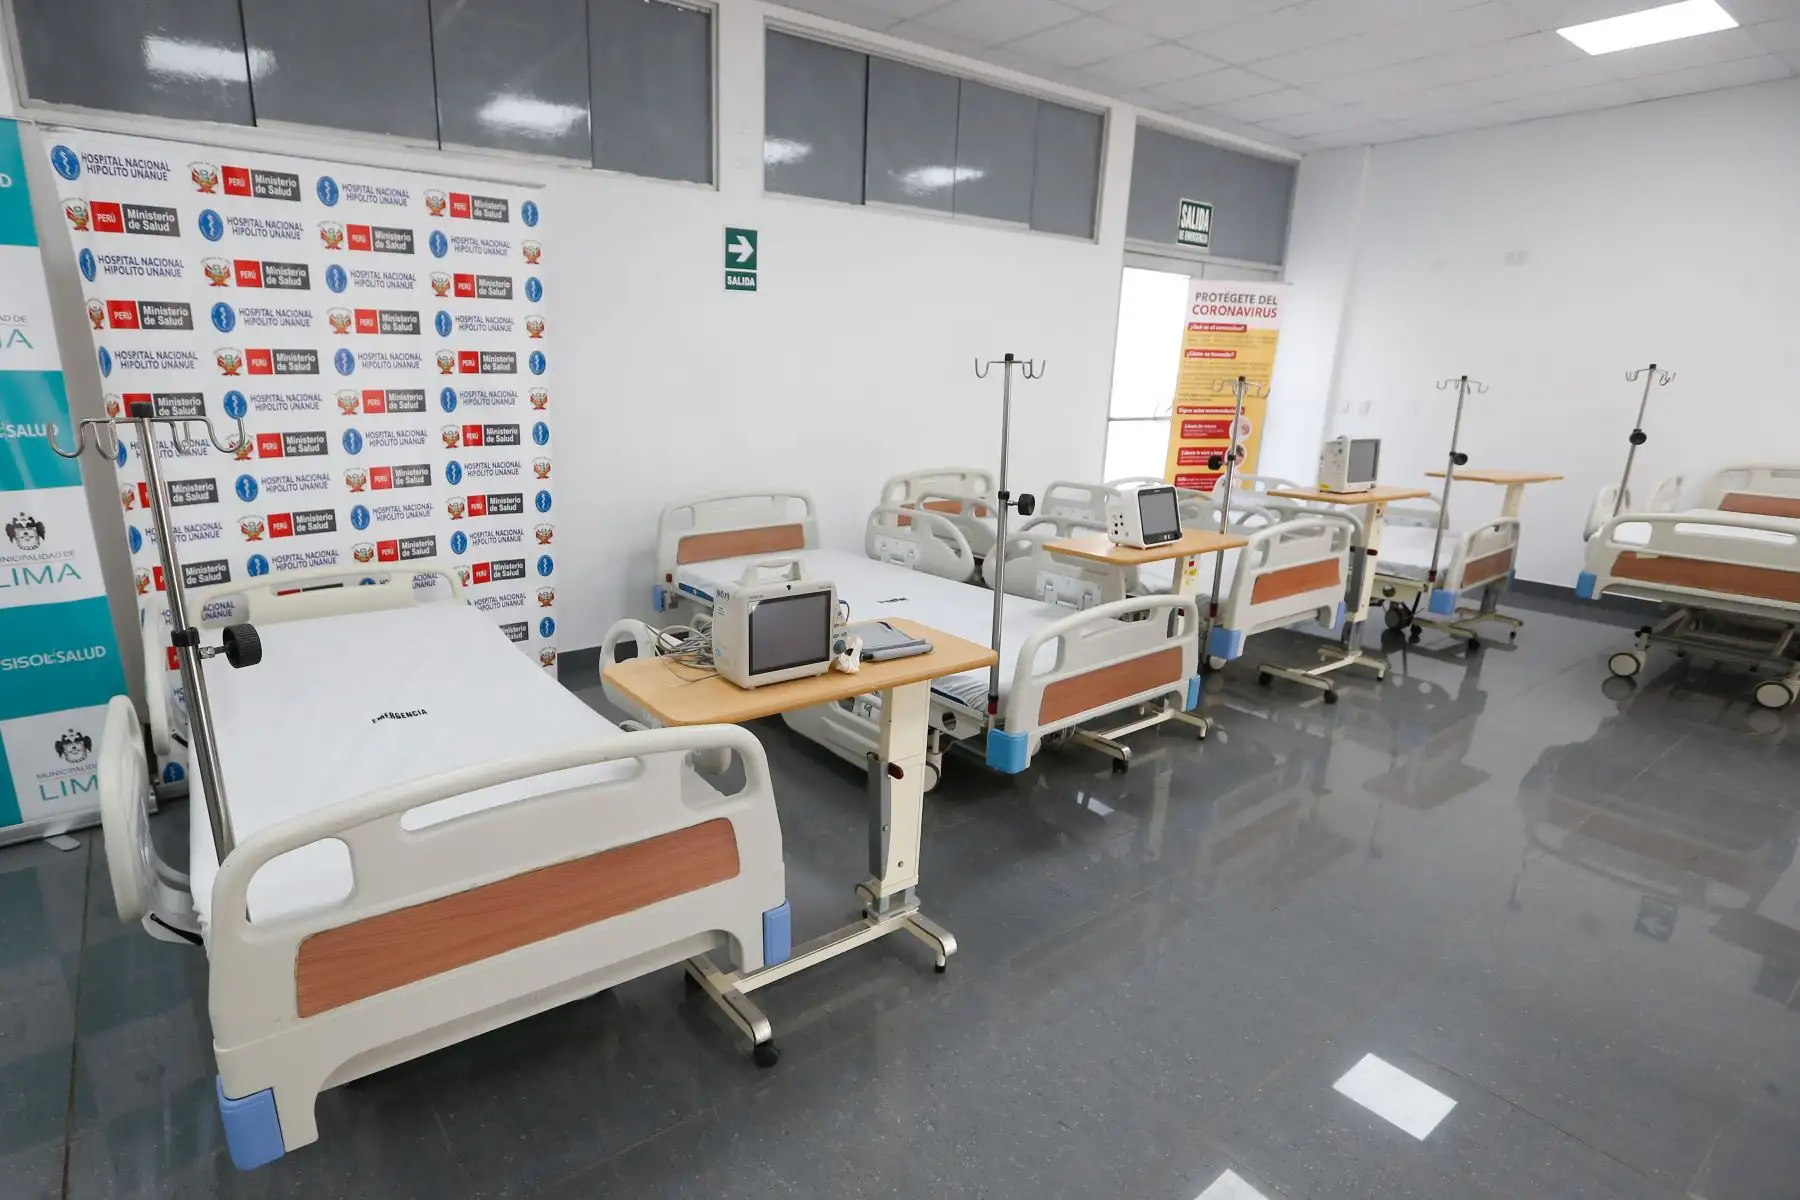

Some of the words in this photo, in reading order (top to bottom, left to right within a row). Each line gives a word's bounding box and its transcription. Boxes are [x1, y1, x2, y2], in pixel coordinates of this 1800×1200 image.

[81, 153, 124, 167] HOSPITAL
[125, 158, 171, 172] NACIONAL
[130, 168, 167, 181] UNANUE
[255, 174, 297, 188] Ministerio
[255, 184, 266, 194] de
[268, 185, 292, 196] Salud
[474, 199, 507, 211] Ministerio
[127, 208, 175, 222] Ministerio
[474, 208, 482, 217] de
[483, 209, 502, 219] Salud
[1180, 203, 1210, 232] SALIDA
[128, 219, 140, 230] de
[142, 220, 170, 232] Salud
[227, 217, 267, 228] HOSPITAL
[266, 220, 304, 231] NACIONAL
[270, 230, 301, 240] UNANUE
[374, 230, 411, 242] Ministerio
[375, 239, 384, 248] de
[386, 240, 406, 250] Salud
[97, 255, 140, 268] HOSPITAL
[141, 257, 184, 268] NACIONAL
[146, 267, 181, 278] UNANUE
[266, 265, 306, 277] Ministerio
[266, 275, 277, 285] de
[278, 275, 302, 286] Salud
[479, 278, 510, 288] Ministerio
[727, 275, 755, 286] SALIDA
[478, 287, 487, 295] de
[488, 287, 506, 296] Salud
[1195, 291, 1256, 304] PROTÉGETE
[1258, 295, 1278, 305] DEL
[143, 305, 188, 316] Ministerio
[239, 308, 274, 317] HOSPITAL
[275, 309, 313, 318] NACIONAL
[1192, 304, 1278, 318] CORONAVIRUS
[144, 315, 155, 325] de
[158, 315, 183, 326] Salud
[280, 318, 310, 327] UNANUE
[381, 313, 417, 323] Ministerio
[382, 322, 391, 331] de
[392, 322, 413, 331] Salud
[114, 350, 155, 360] HOSPITAL
[156, 351, 198, 360] NACIONAL
[276, 353, 316, 362] Ministerio
[357, 352, 388, 361] HOSPITAL
[389, 353, 422, 361] NACIONAL
[483, 355, 515, 363] Ministerio
[161, 360, 194, 369] UNANUE
[277, 362, 287, 371] de
[288, 362, 311, 371] Salud
[393, 361, 419, 369] UNANUE
[492, 363, 511, 371] Salud
[250, 394, 285, 403] HOSPITAL
[285, 393, 322, 402] NACIONAL
[388, 393, 423, 401] Ministerio
[459, 390, 488, 399] HOSPITAL
[488, 390, 518, 399] NACIONAL
[158, 396, 201, 405] Ministerio
[389, 401, 398, 410] de
[399, 401, 419, 409] Salud
[491, 398, 515, 406] UNANUE
[158, 405, 170, 413] de
[172, 405, 197, 414] Salud
[290, 402, 319, 410] UNANUE
[365, 430, 395, 439] HOSPITAL
[396, 429, 428, 439] NACIONAL
[486, 427, 518, 435] Ministerio
[286, 435, 324, 444] Ministerio
[486, 435, 495, 443] de
[496, 434, 514, 442] Salud
[287, 445, 297, 453] de
[298, 443, 320, 453] Salud
[395, 468, 429, 477] Ministerio
[261, 476, 295, 486] HOSPITAL
[295, 473, 330, 483] NACIONAL
[395, 477, 404, 485] de
[405, 475, 424, 484] Salud
[172, 482, 214, 493] Ministerio
[299, 481, 328, 491] UNANUE
[173, 493, 184, 502] de
[185, 491, 209, 501] Salud
[490, 496, 521, 504] Ministerio
[372, 505, 402, 515] HOSPITAL
[402, 503, 433, 511] NACIONAL
[499, 503, 517, 511] Salud
[296, 513, 333, 523] Ministerio
[405, 510, 430, 519] UNANUE
[296, 524, 306, 532] de
[307, 521, 329, 531] Salud
[469, 530, 495, 539] HOSPITAL
[498, 535, 522, 543] UNANUE
[402, 539, 434, 549] Ministerio
[402, 549, 410, 557] de
[411, 546, 430, 556] Salud
[0, 551, 62, 563] NICIPALIDAD
[272, 554, 304, 566] HOSPITAL
[303, 549, 339, 562] NACIONAL
[309, 557, 336, 567] UNANUE
[185, 563, 226, 576] Ministerio
[493, 562, 523, 572] Ministerio
[186, 576, 197, 584] de
[198, 572, 222, 583] Salud
[502, 569, 519, 577] Salud
[56, 645, 106, 663] SALUD
[39, 774, 98, 801] LIM
